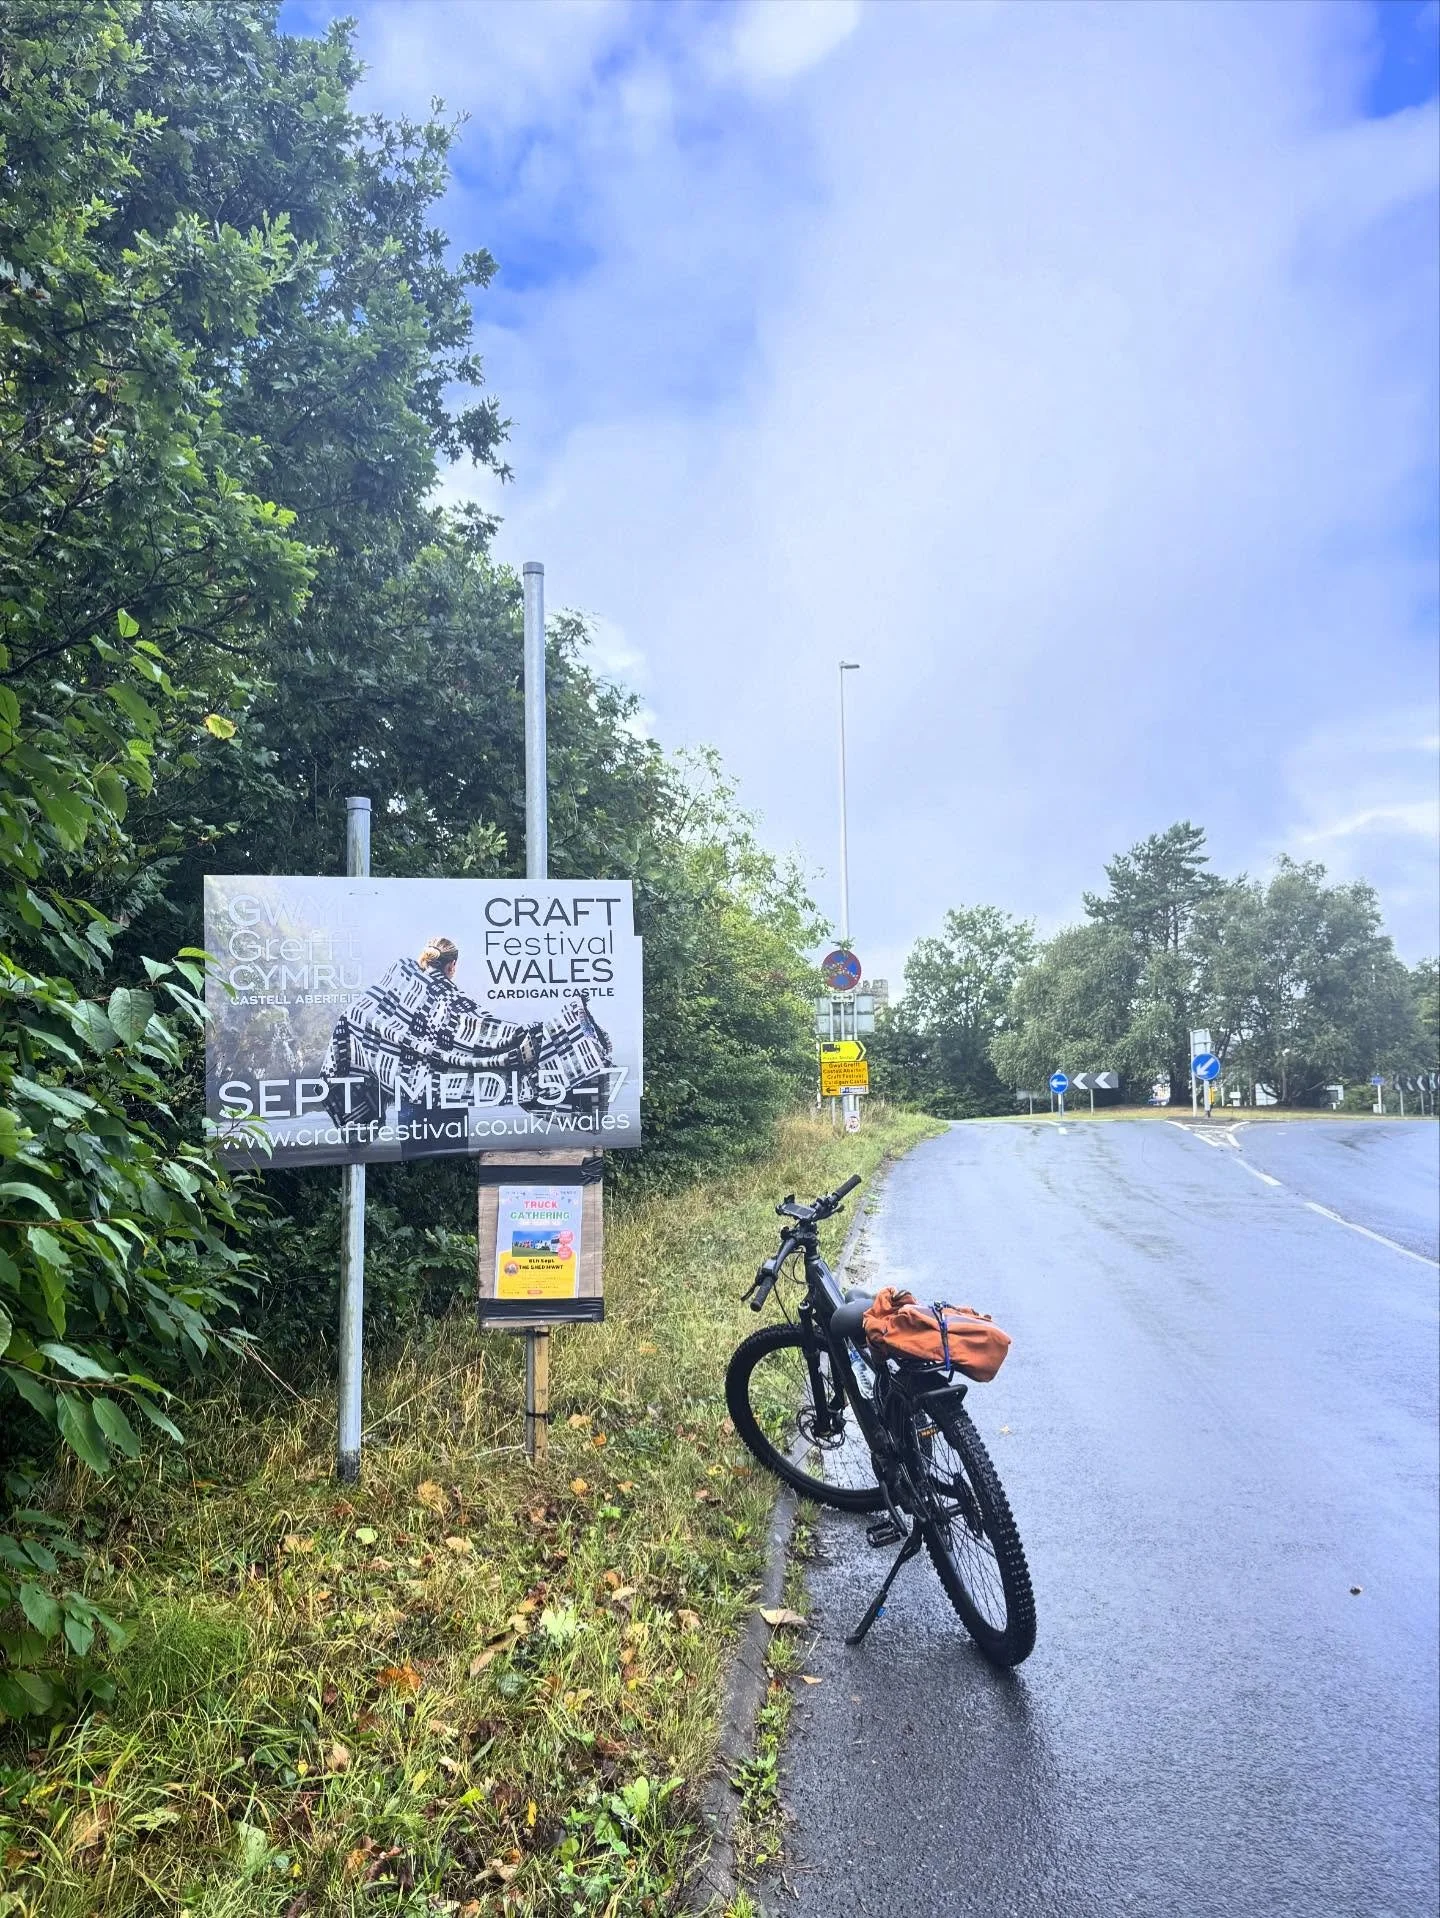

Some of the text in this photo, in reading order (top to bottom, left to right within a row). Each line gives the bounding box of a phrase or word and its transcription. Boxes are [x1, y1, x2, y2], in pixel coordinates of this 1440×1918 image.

[485, 898, 621, 927] CRAFT
[228, 929, 361, 962] Grefft
[486, 930, 613, 956] Festival
[228, 964, 362, 991] CYMRU
[486, 958, 614, 984] WALES
[230, 995, 291, 1006] CASTELL
[295, 993, 363, 1005] ABERTEIF
[487, 989, 559, 1000] CARDIGAN
[563, 988, 615, 998] CASTLE
[218, 1077, 364, 1119] SEPT
[395, 1070, 518, 1111] MEDI
[524, 1201, 557, 1209] TRUCK
[511, 1211, 570, 1220] GATHERING
